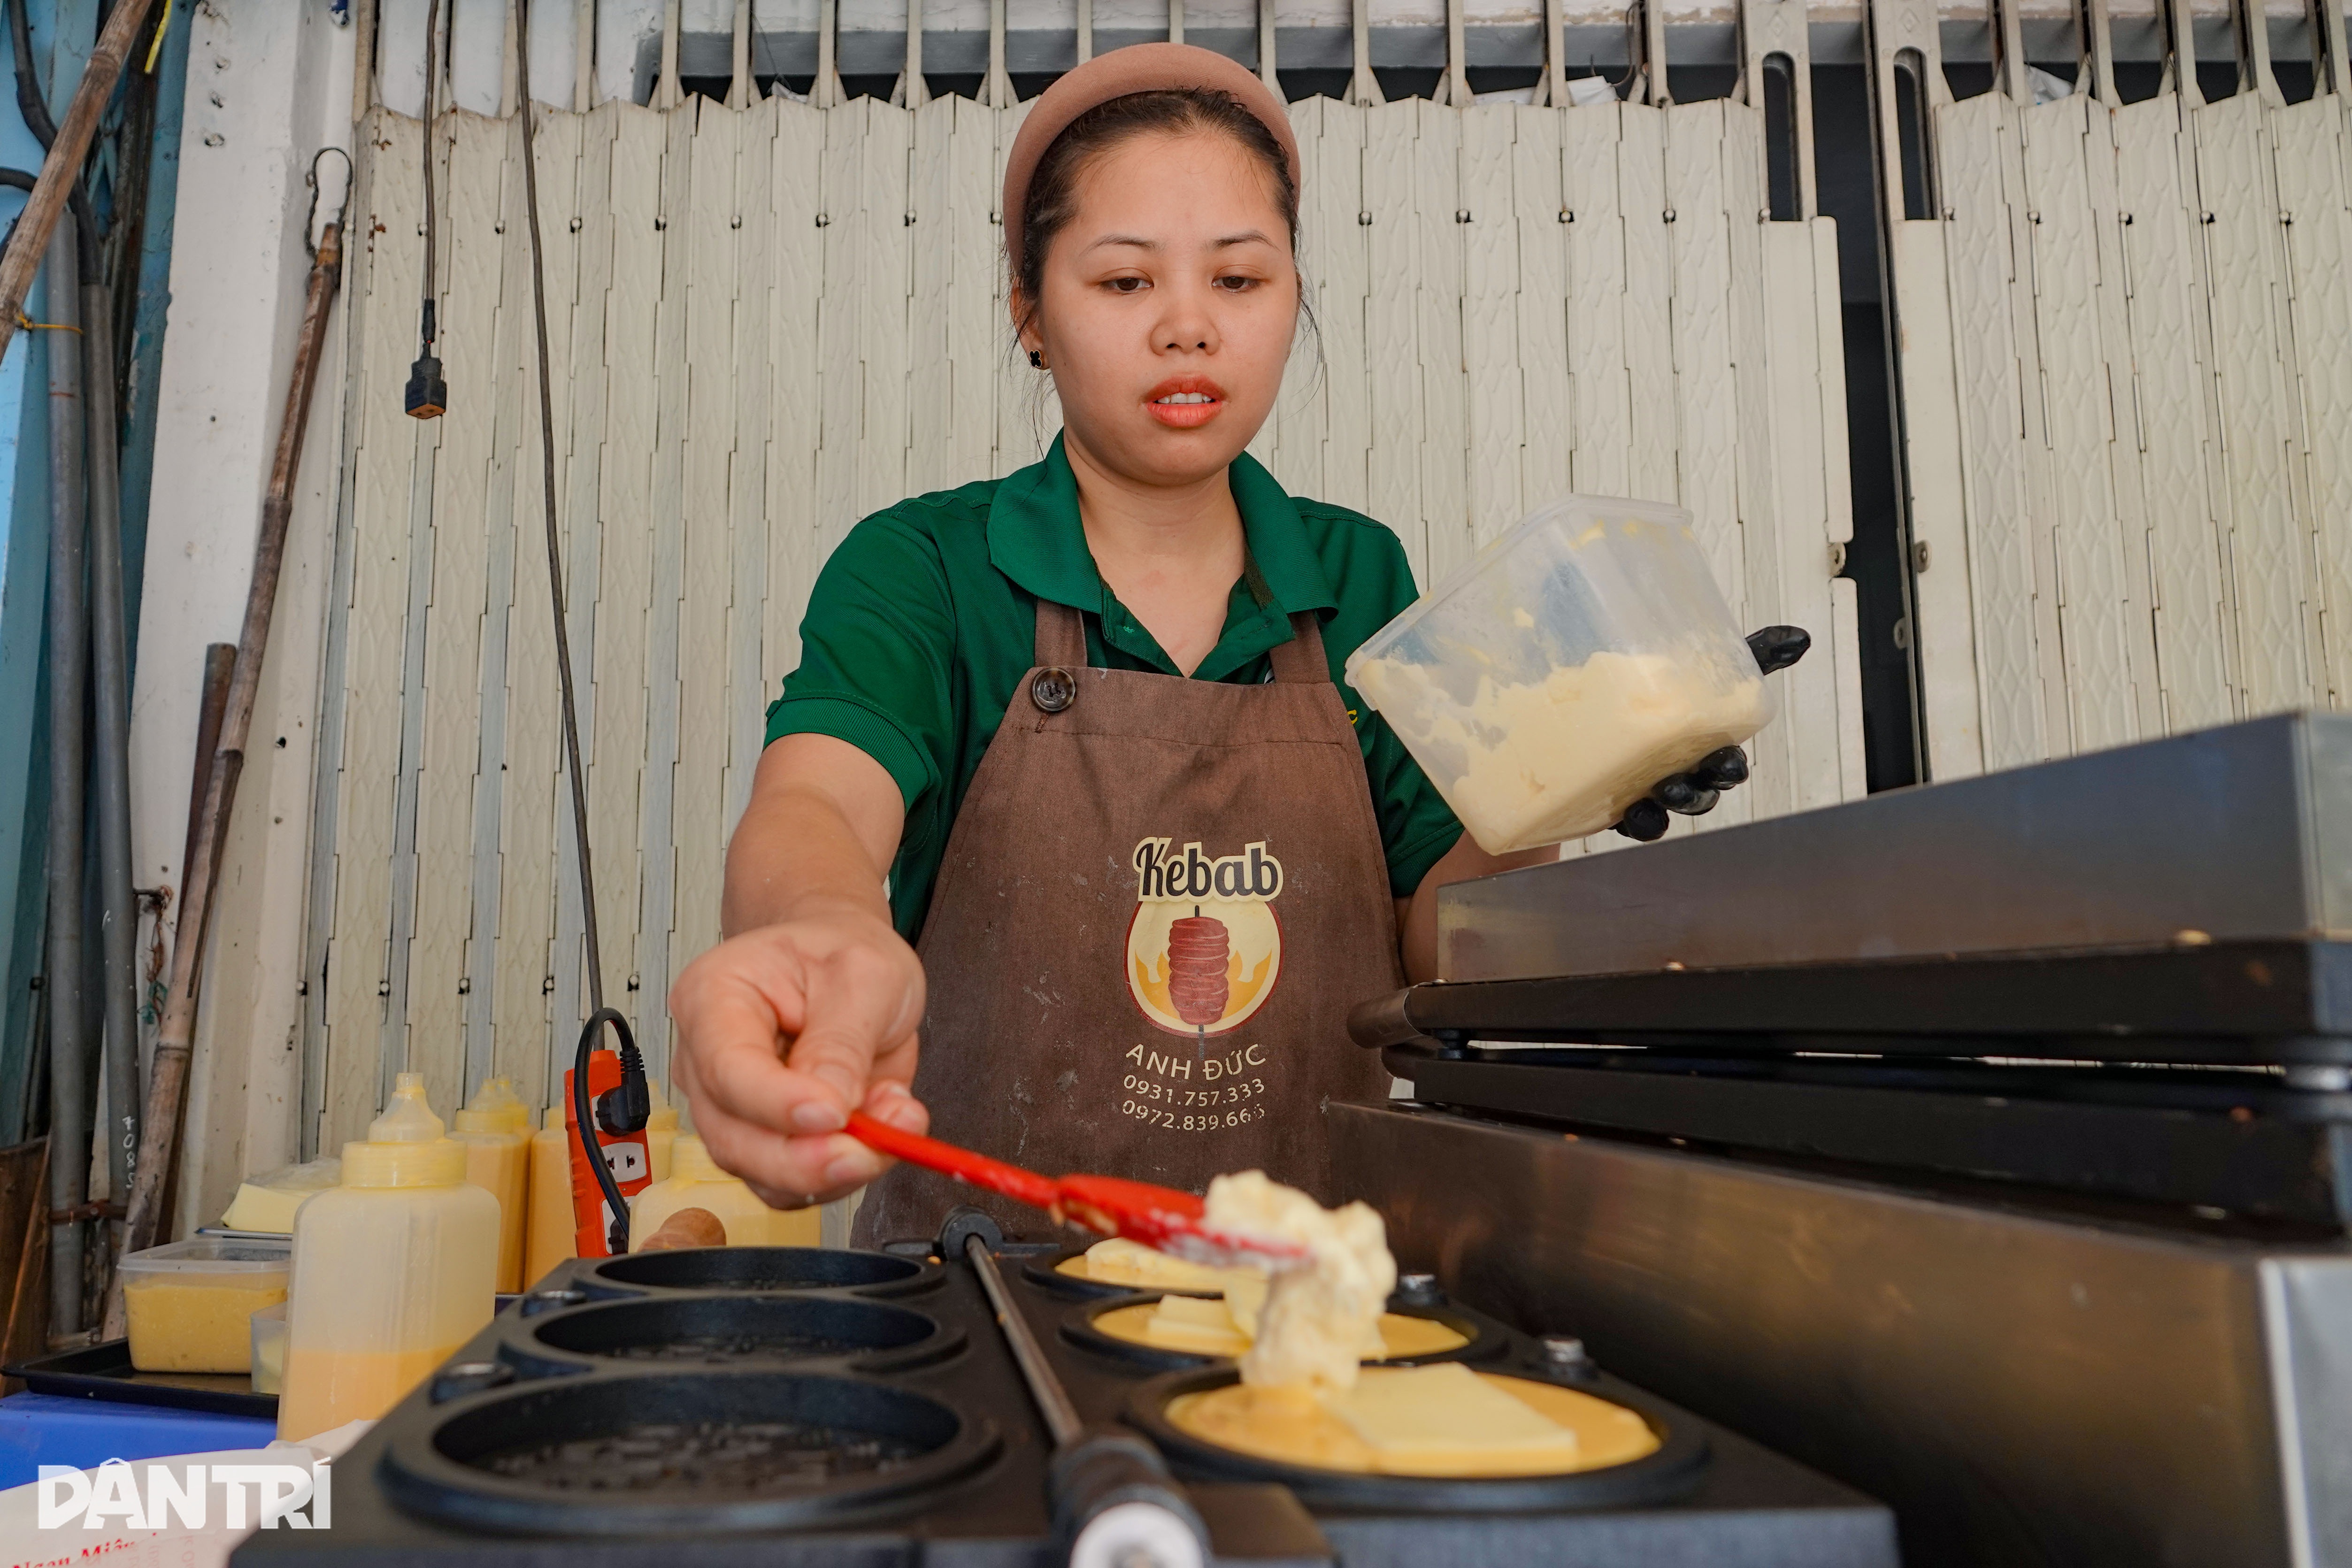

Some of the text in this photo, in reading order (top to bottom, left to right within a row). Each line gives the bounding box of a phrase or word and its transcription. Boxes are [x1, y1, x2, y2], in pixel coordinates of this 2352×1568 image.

[1136, 843, 1278, 896] Kebab
[1126, 1044, 1266, 1080] ANH ĐỨC
[1124, 1075, 1265, 1107] 0931.757.333
